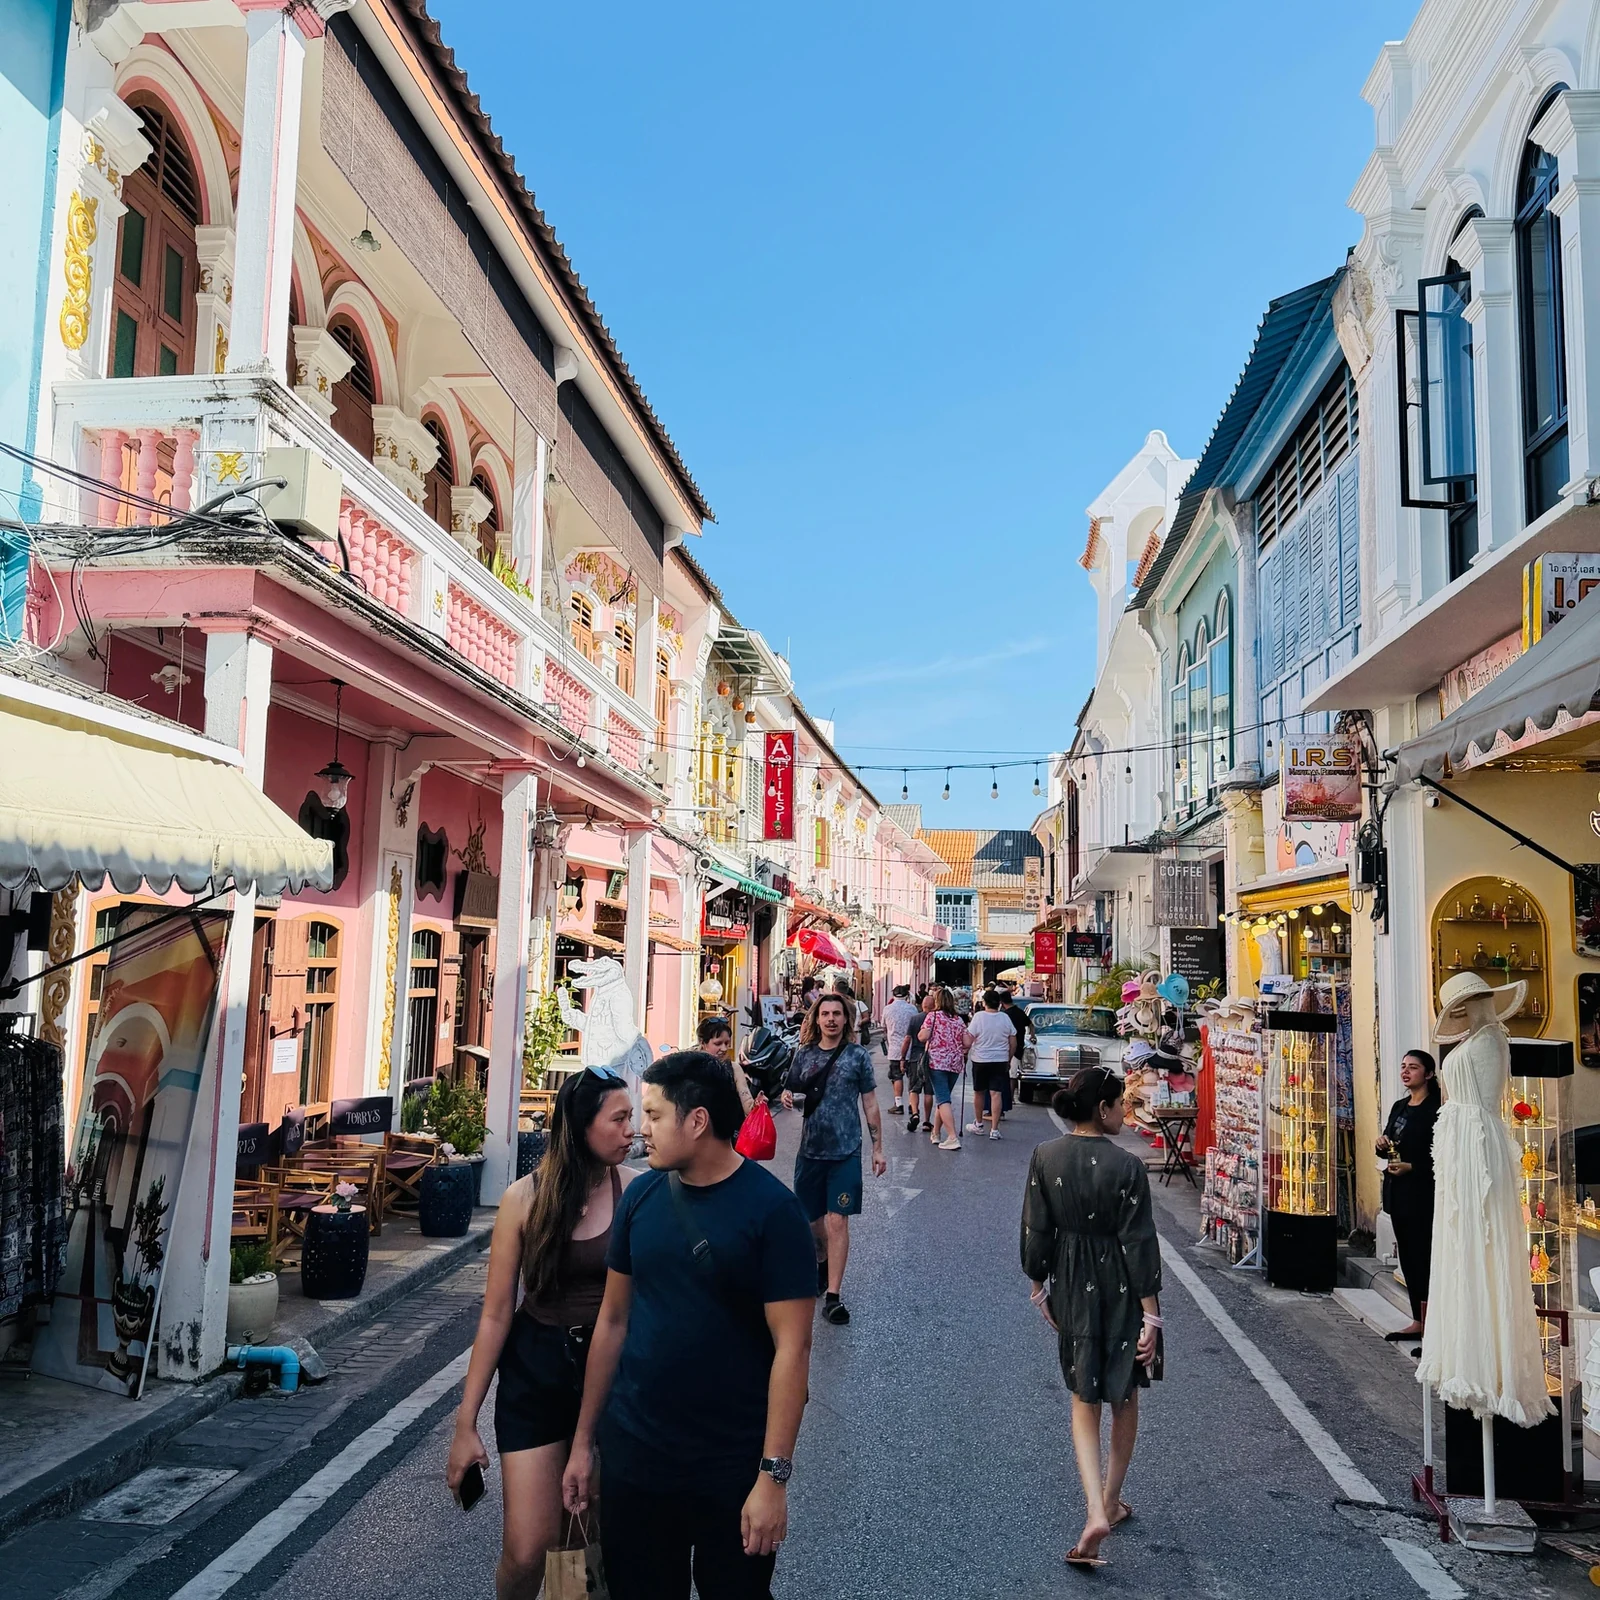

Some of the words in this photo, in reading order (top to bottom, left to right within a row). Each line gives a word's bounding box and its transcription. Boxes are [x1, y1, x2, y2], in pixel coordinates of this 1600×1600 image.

[1291, 748, 1353, 767] I.R.S
[1160, 865, 1203, 878] COFFEE
[1158, 912, 1204, 921] CHOCOLATE
[346, 1108, 381, 1126] TORRY'S
